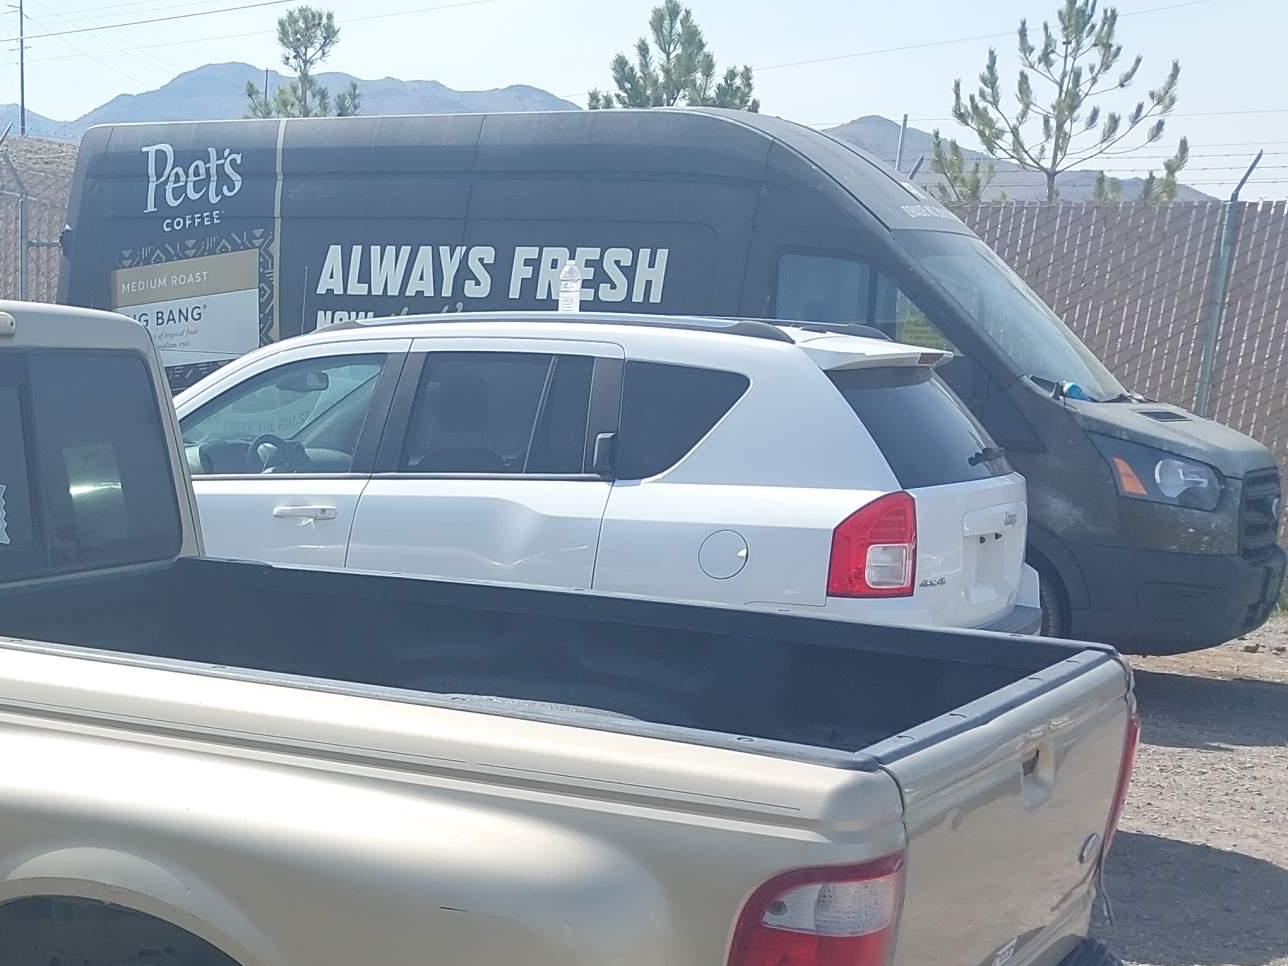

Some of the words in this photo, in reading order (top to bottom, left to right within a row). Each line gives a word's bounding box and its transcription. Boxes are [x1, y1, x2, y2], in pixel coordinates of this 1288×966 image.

[141, 143, 242, 213] Peet's
[162, 210, 221, 232] COFFEE
[121, 278, 167, 294] MEDIUM
[171, 271, 208, 287] ROAST
[316, 245, 496, 298] ALWAYS
[508, 246, 669, 303] FRESH
